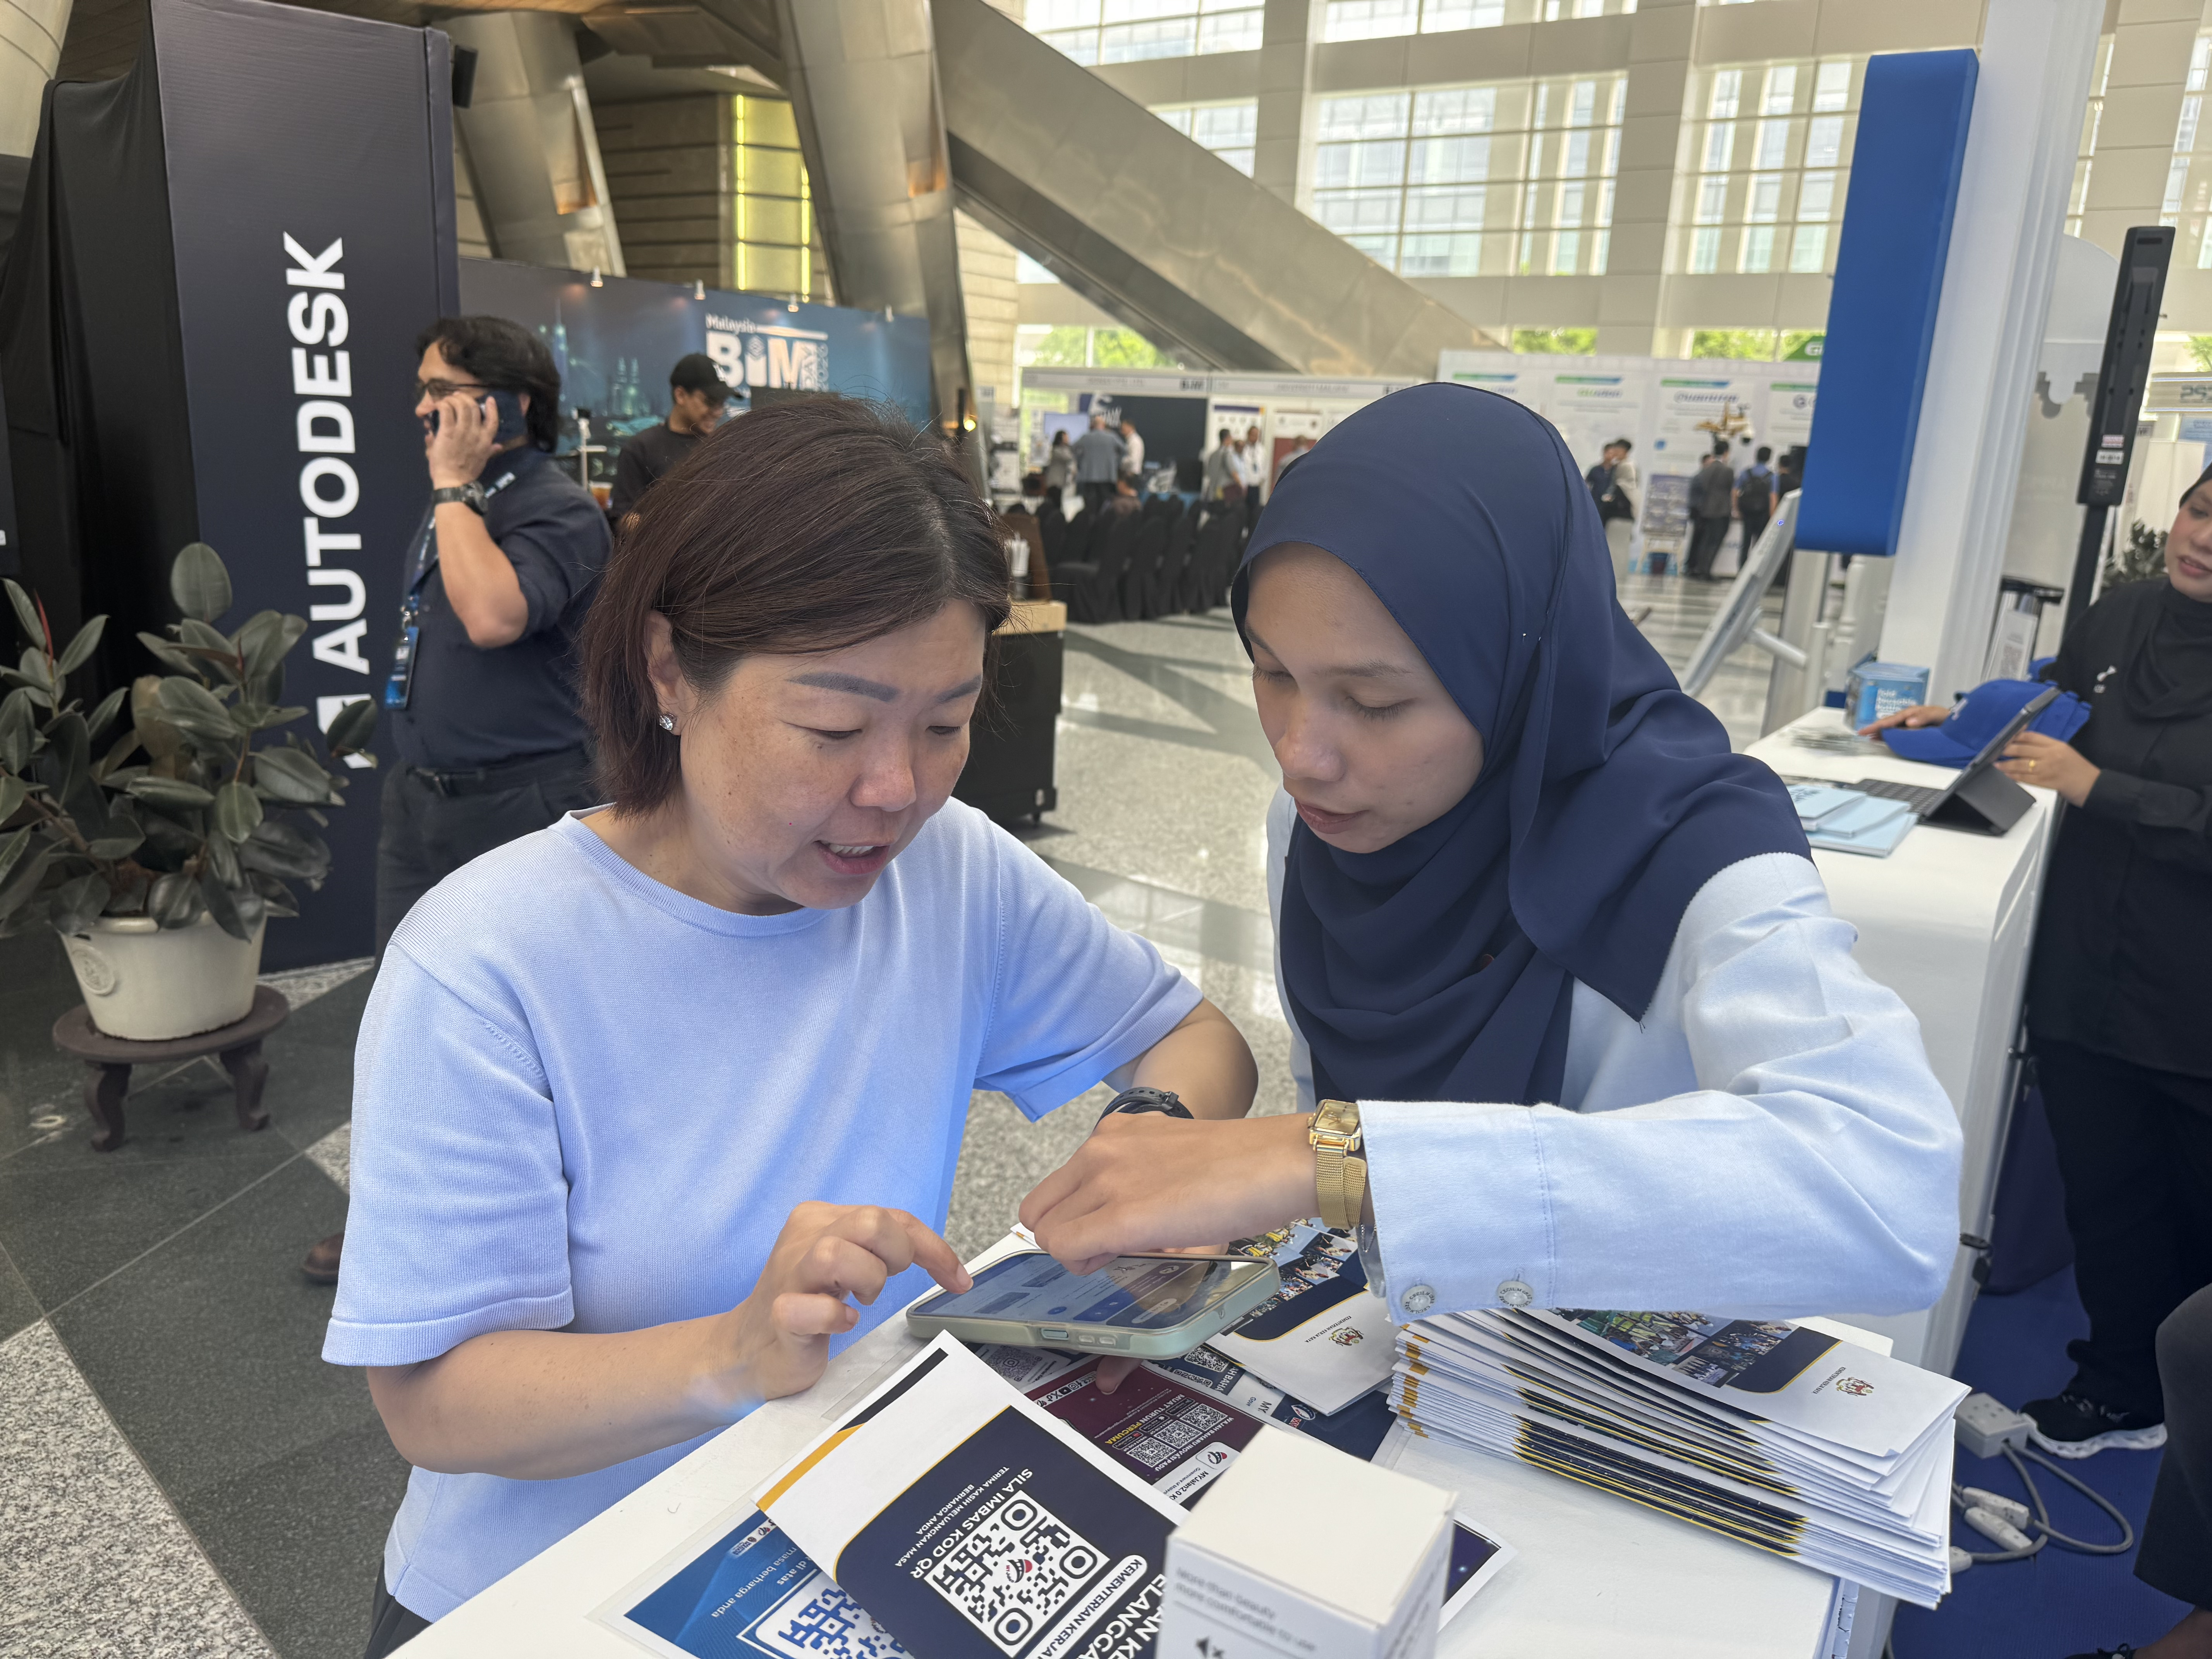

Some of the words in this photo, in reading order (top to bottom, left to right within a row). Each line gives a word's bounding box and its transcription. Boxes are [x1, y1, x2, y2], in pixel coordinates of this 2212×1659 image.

[706, 312, 757, 335] Malaysia
[282, 231, 369, 675] AUTODESK
[1163, 1394, 1185, 1408] MUAT
[1258, 1401, 1272, 1413] MY
[1139, 1407, 1165, 1423] TURUN
[1104, 1422, 1142, 1444] PERCUMA
[1192, 1429, 1214, 1446] BAHARU
[1155, 1459, 1171, 1471] PADU
[982, 1467, 1009, 1487] TERIMA
[1002, 1468, 1032, 1492] SILA
[1175, 1471, 1209, 1495] MYJalan2.0
[936, 1484, 974, 1516] BERHARGA
[962, 1487, 984, 1505] KASIH
[962, 1492, 1005, 1530] IMBAS
[915, 1516, 936, 1534] ANDA
[915, 1504, 963, 1547] MELUANGKAN
[933, 1529, 963, 1557] KOD
[773, 1547, 797, 1565] masa
[795, 1561, 806, 1570] di
[895, 1547, 917, 1566] MASA
[776, 1569, 796, 1585] atas
[910, 1558, 932, 1578] QR
[735, 1566, 776, 1597] berharga
[1073, 1559, 1142, 1625] KEMENTERIAN
[711, 1598, 735, 1617] anda
[1077, 1573, 1167, 1659] ELANGGA
[1135, 1606, 1165, 1642] AN
[1041, 1623, 1078, 1657] KERJA
